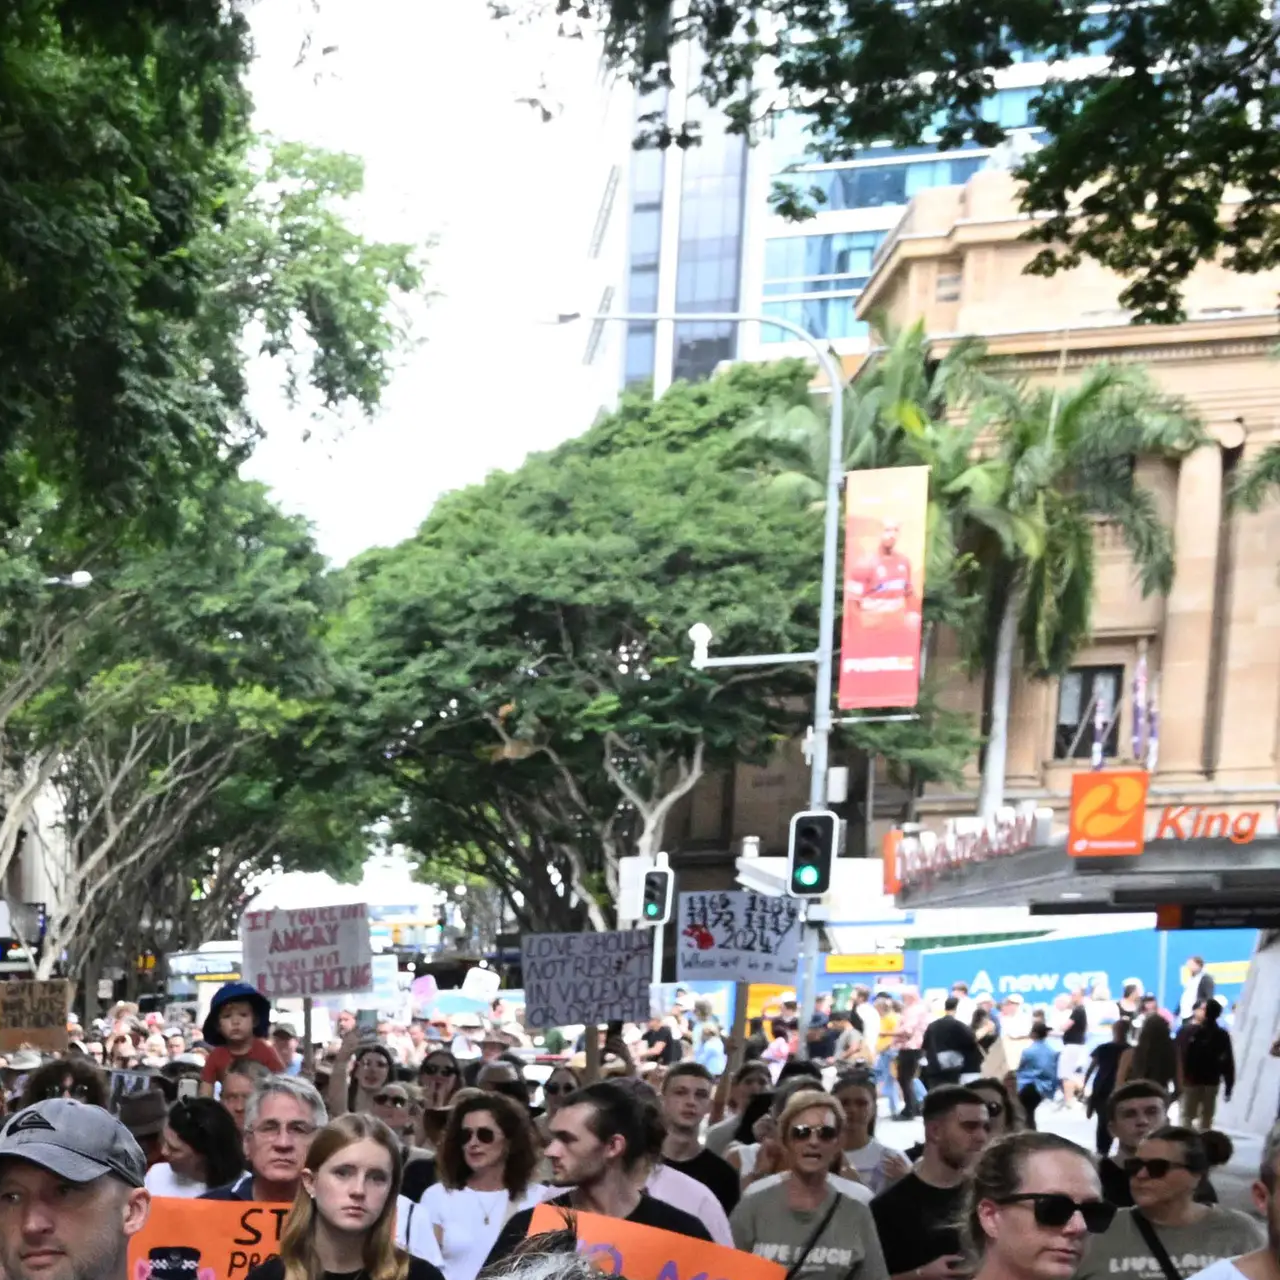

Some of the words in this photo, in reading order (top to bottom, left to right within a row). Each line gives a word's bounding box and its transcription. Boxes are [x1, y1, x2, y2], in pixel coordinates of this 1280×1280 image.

[1155, 804, 1261, 844] King
[269, 923, 339, 954] ANGRY
[526, 936, 576, 958] LOVE
[527, 959, 566, 979] NOT
[970, 970, 994, 993] A
[999, 973, 1059, 992] new
